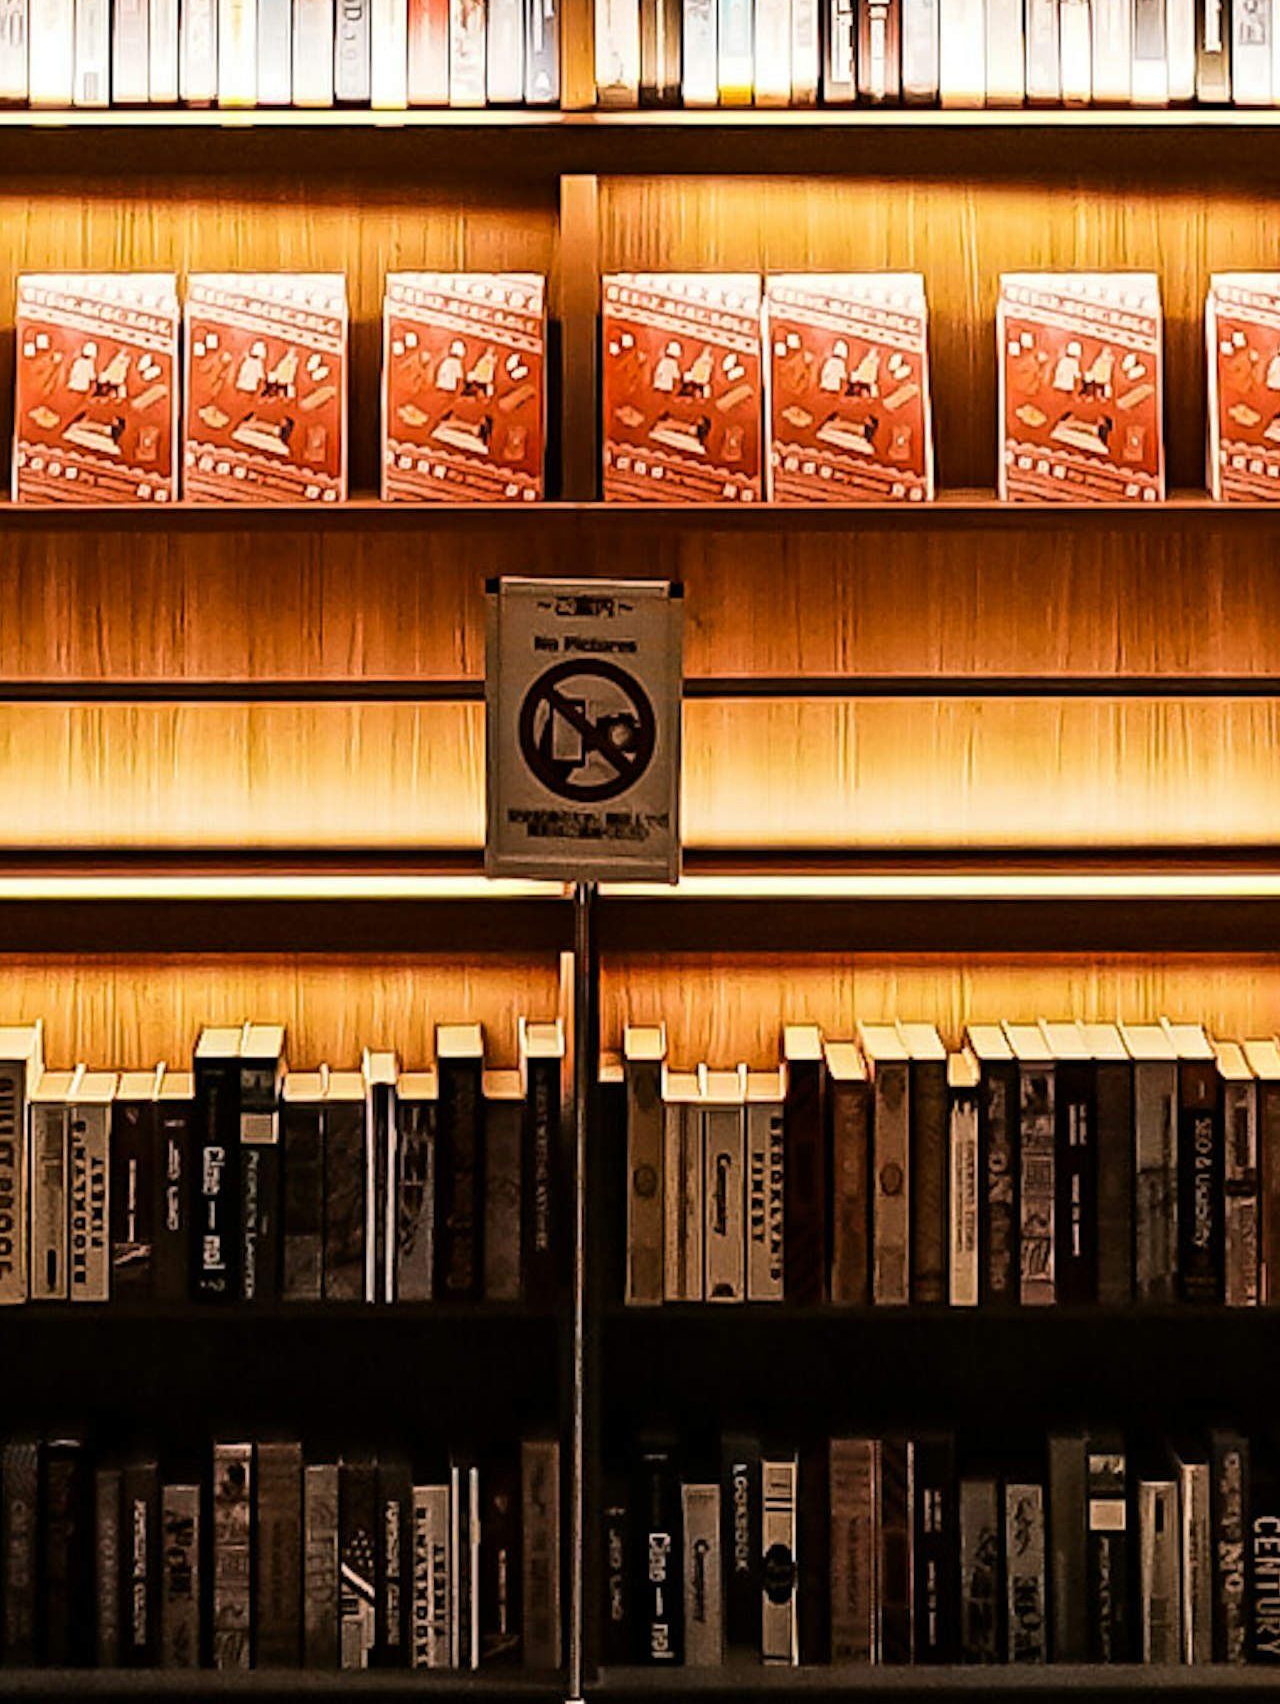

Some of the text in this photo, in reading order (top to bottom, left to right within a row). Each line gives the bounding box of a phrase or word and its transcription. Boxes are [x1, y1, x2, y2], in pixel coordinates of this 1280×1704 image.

[534, 636, 637, 653] No Pictures
[713, 1151, 733, 1236] Company
[751, 1151, 765, 1245] FINEST
[1190, 1118, 1213, 1248] SEO Usability
